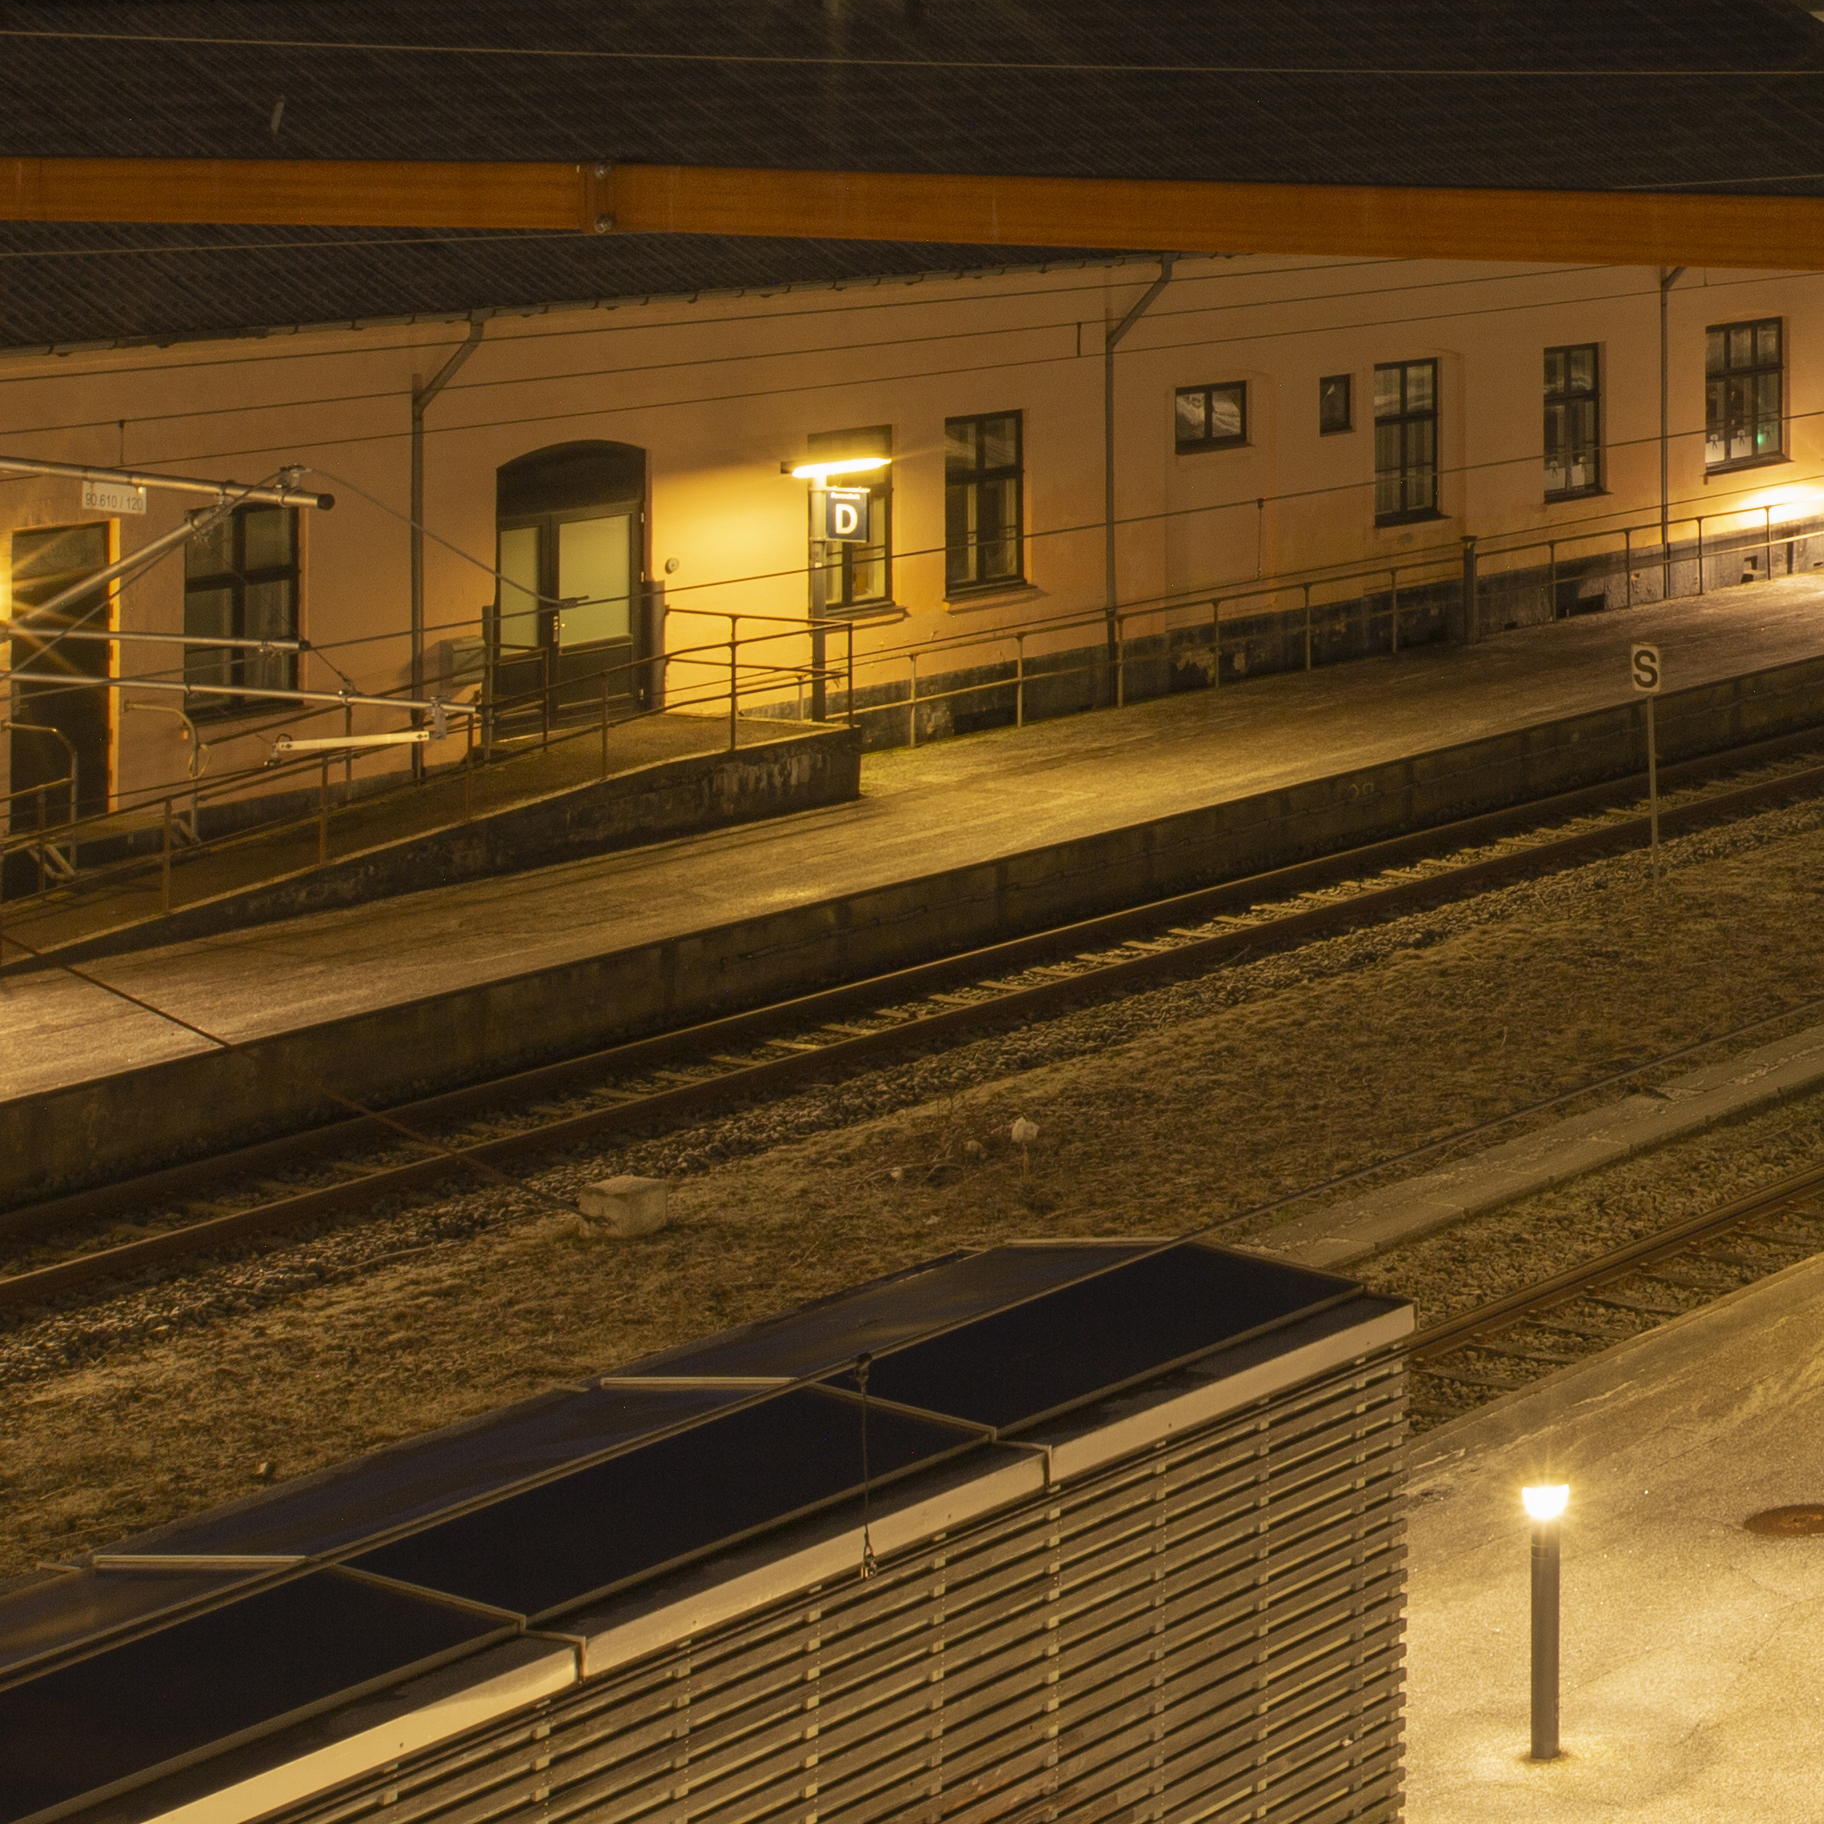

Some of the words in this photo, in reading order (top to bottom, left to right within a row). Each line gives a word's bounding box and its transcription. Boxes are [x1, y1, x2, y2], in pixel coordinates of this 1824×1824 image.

[85, 492, 117, 508] 90.610
[126, 496, 144, 511] 120
[835, 503, 858, 534] D
[1633, 649, 1658, 688] S
